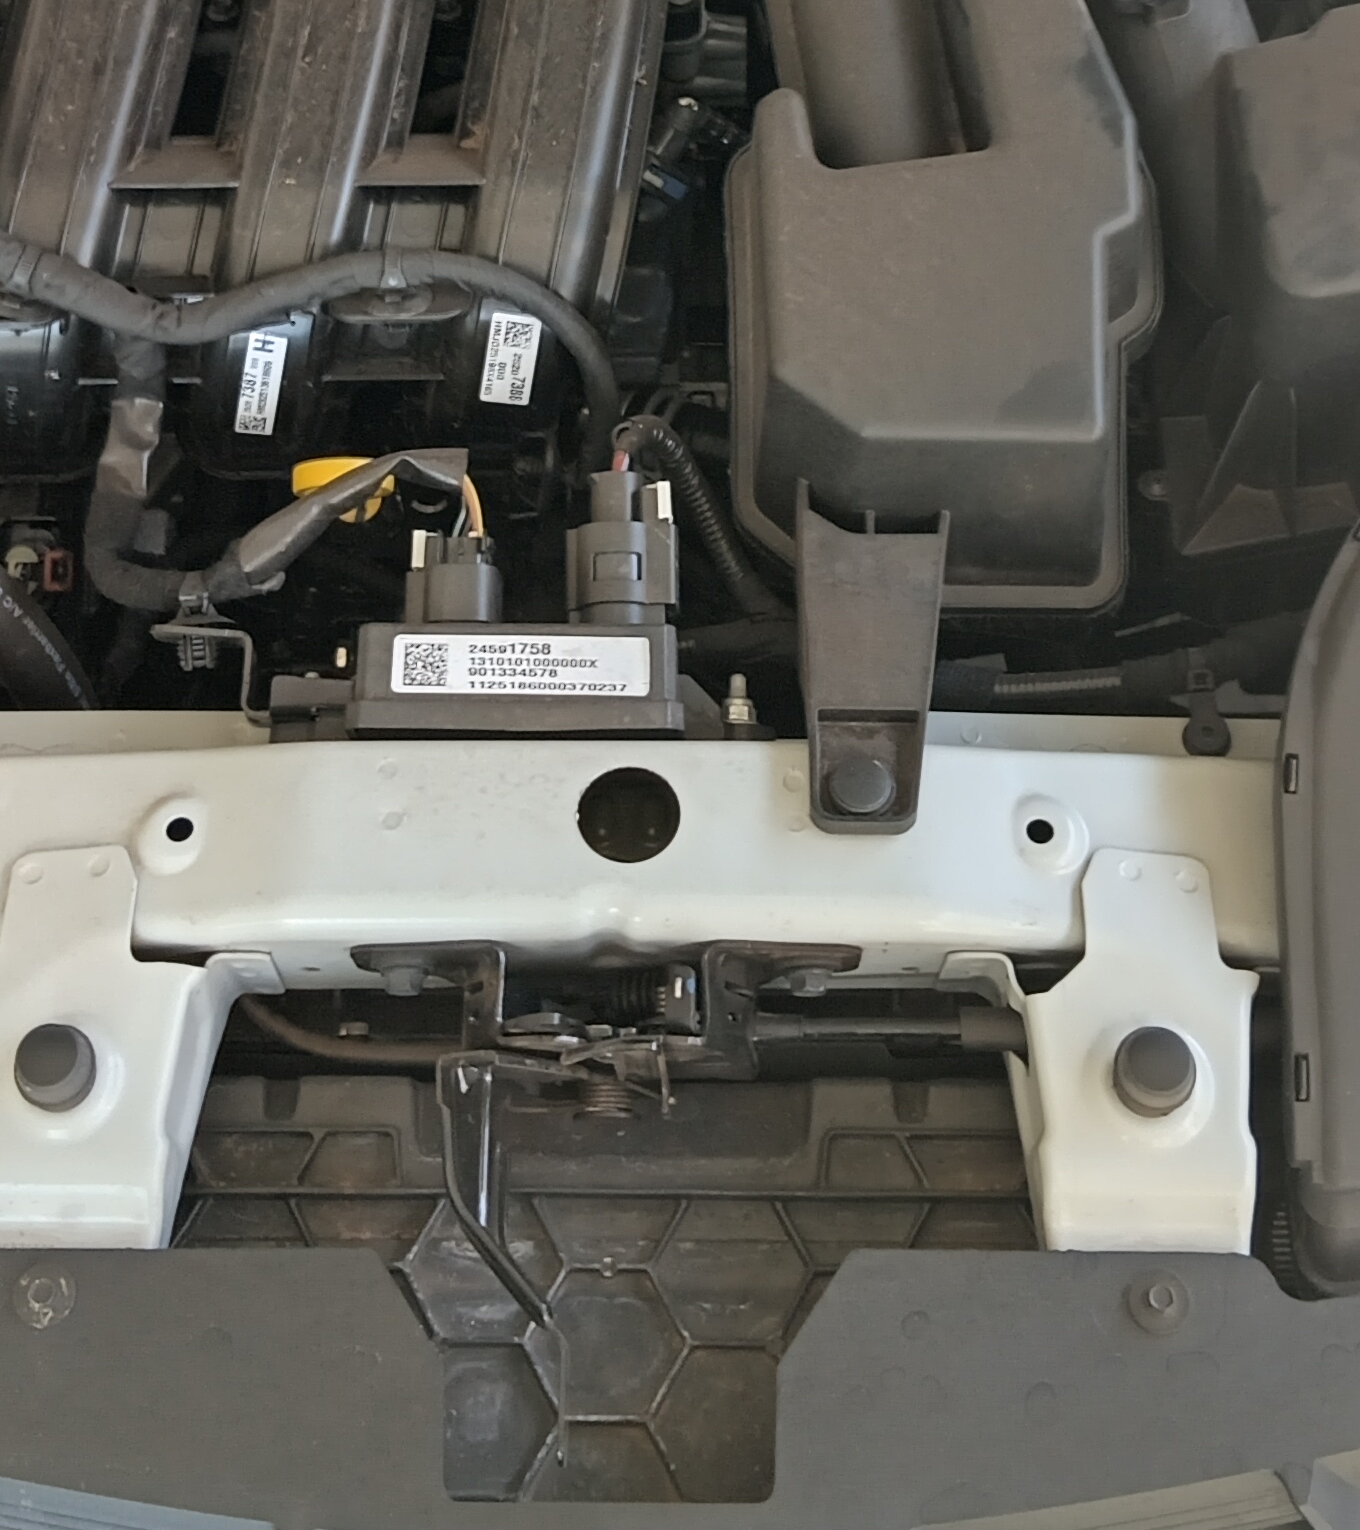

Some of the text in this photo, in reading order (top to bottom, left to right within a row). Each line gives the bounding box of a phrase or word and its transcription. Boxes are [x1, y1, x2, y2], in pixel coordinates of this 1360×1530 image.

[252, 337, 275, 353] H
[3, 596, 24, 618] A/C
[468, 643, 551, 655] 24591758
[469, 657, 599, 668] 1310101000000X
[468, 667, 558, 678] 901334578
[468, 681, 627, 692] 1125186000370237
